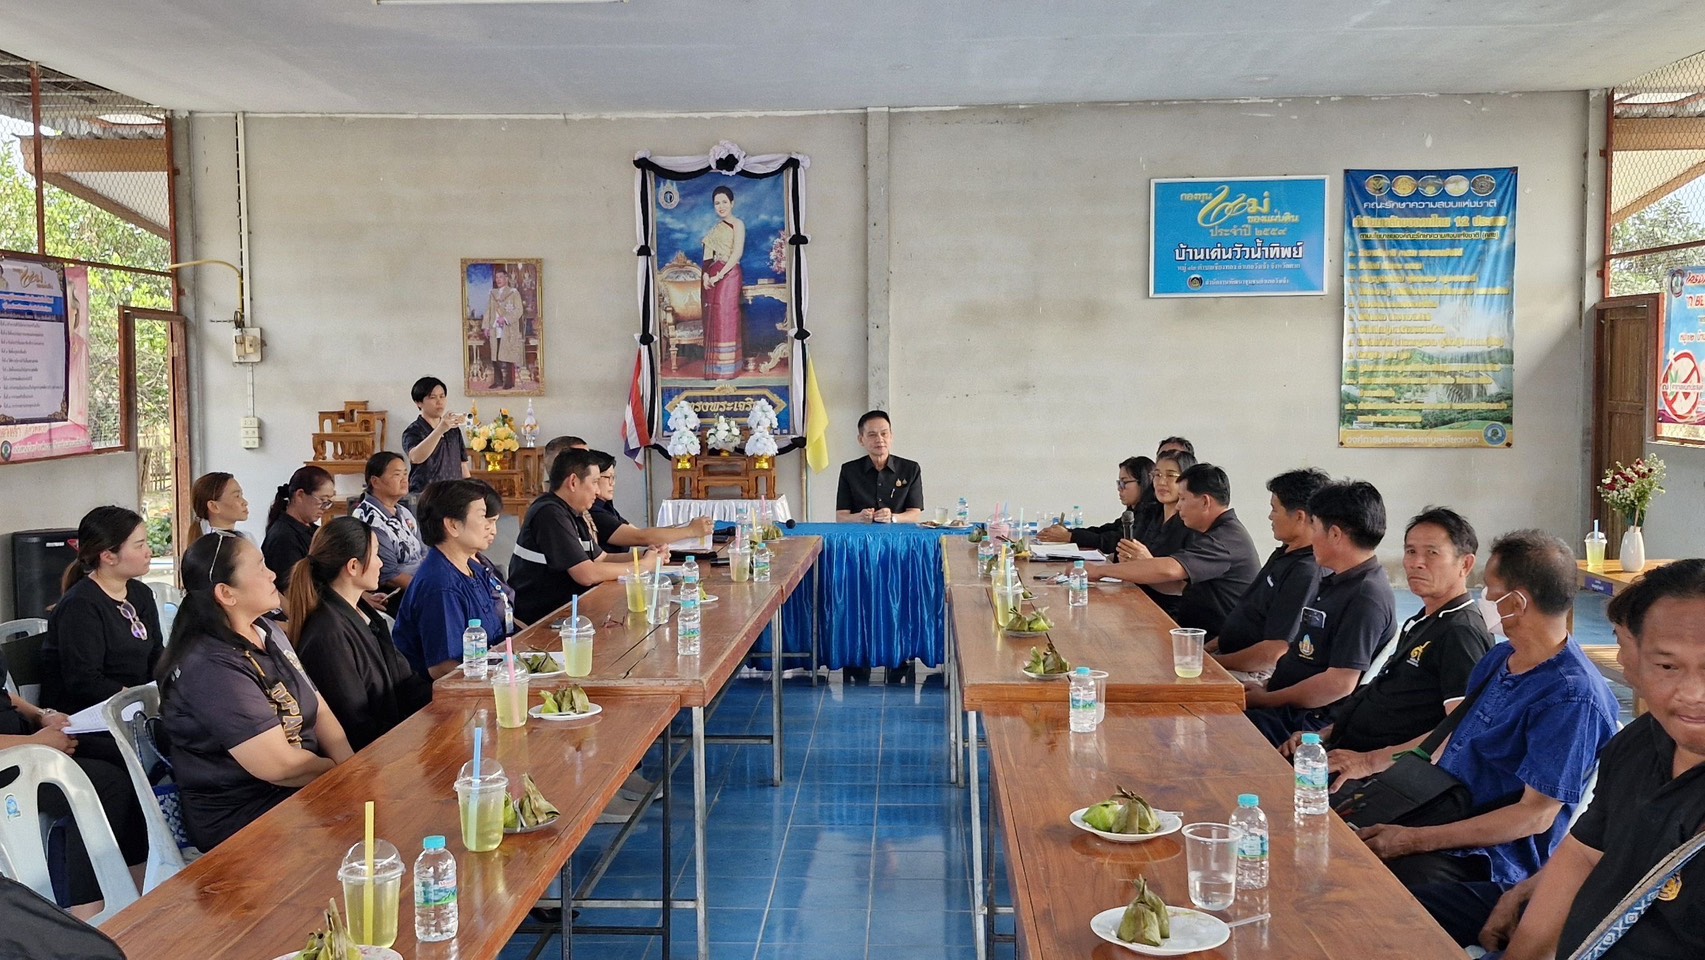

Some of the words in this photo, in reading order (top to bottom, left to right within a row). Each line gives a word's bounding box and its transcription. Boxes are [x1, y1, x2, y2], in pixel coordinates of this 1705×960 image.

[1363, 199, 1497, 209] คณะรักษาความสงบแห่งชาติ
[1210, 224, 1252, 237] ประจำปี
[1174, 238, 1304, 261] บ้านเด่นวัวน้ำทิพย์
